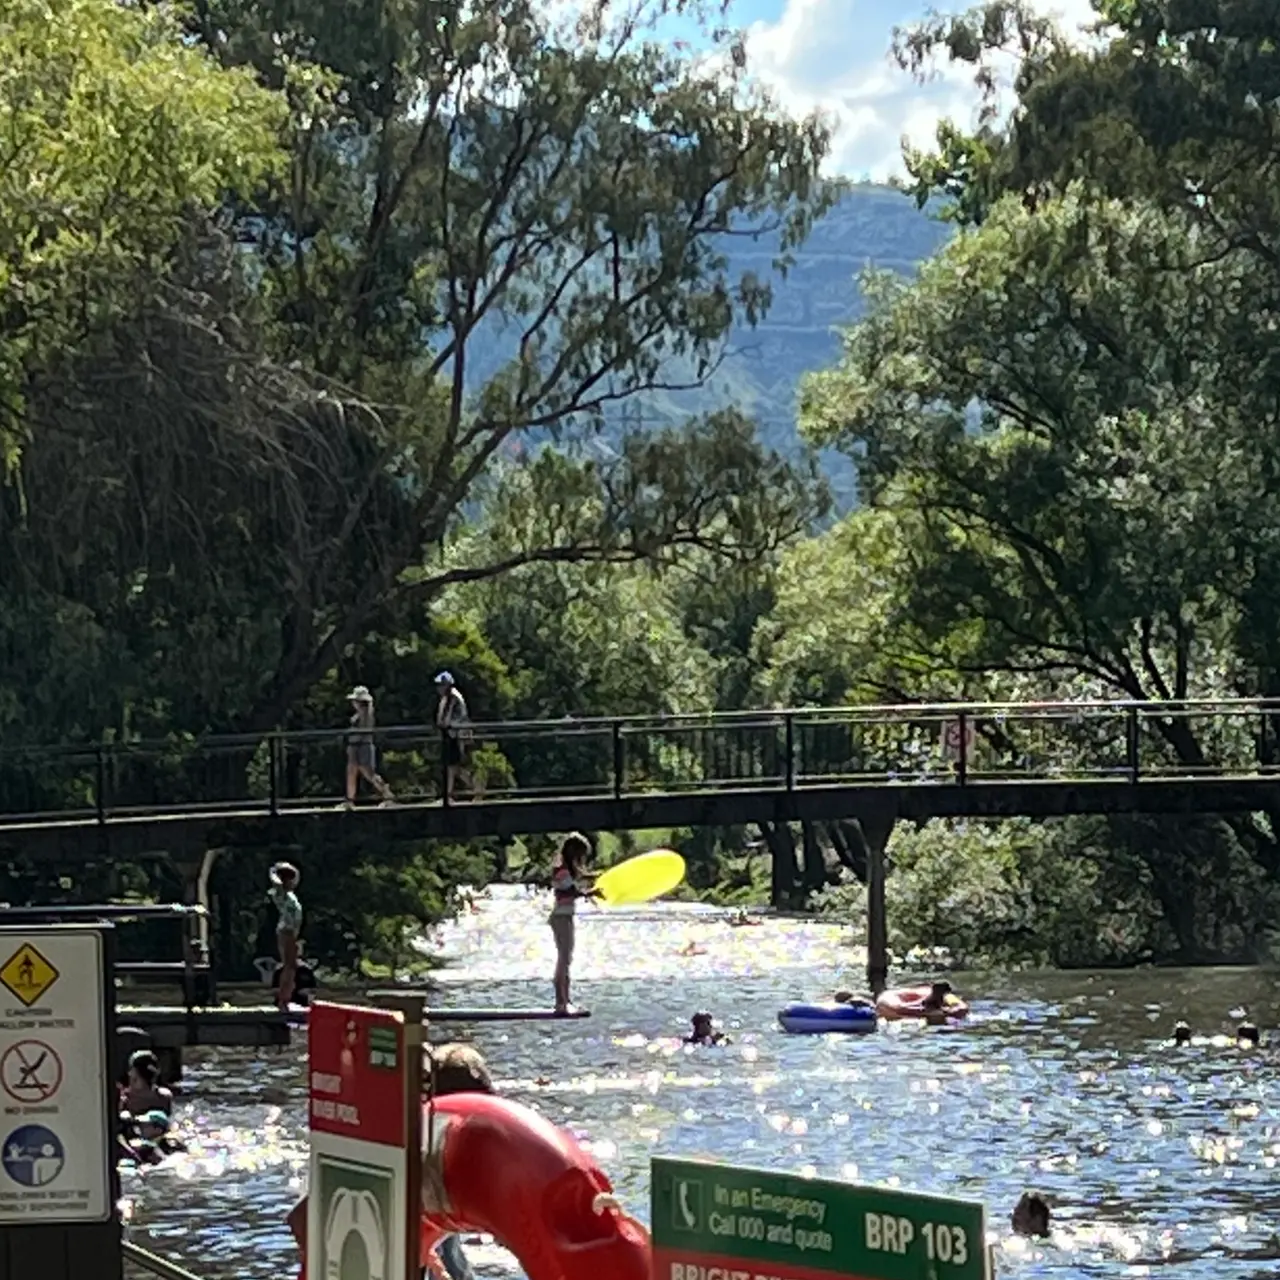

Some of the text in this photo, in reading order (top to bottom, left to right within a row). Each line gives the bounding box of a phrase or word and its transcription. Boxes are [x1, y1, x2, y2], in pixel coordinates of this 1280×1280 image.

[715, 1183, 826, 1224] In an Emergency
[709, 1211, 833, 1252] Call 000 and quote
[864, 1212, 968, 1266] BRP 103
